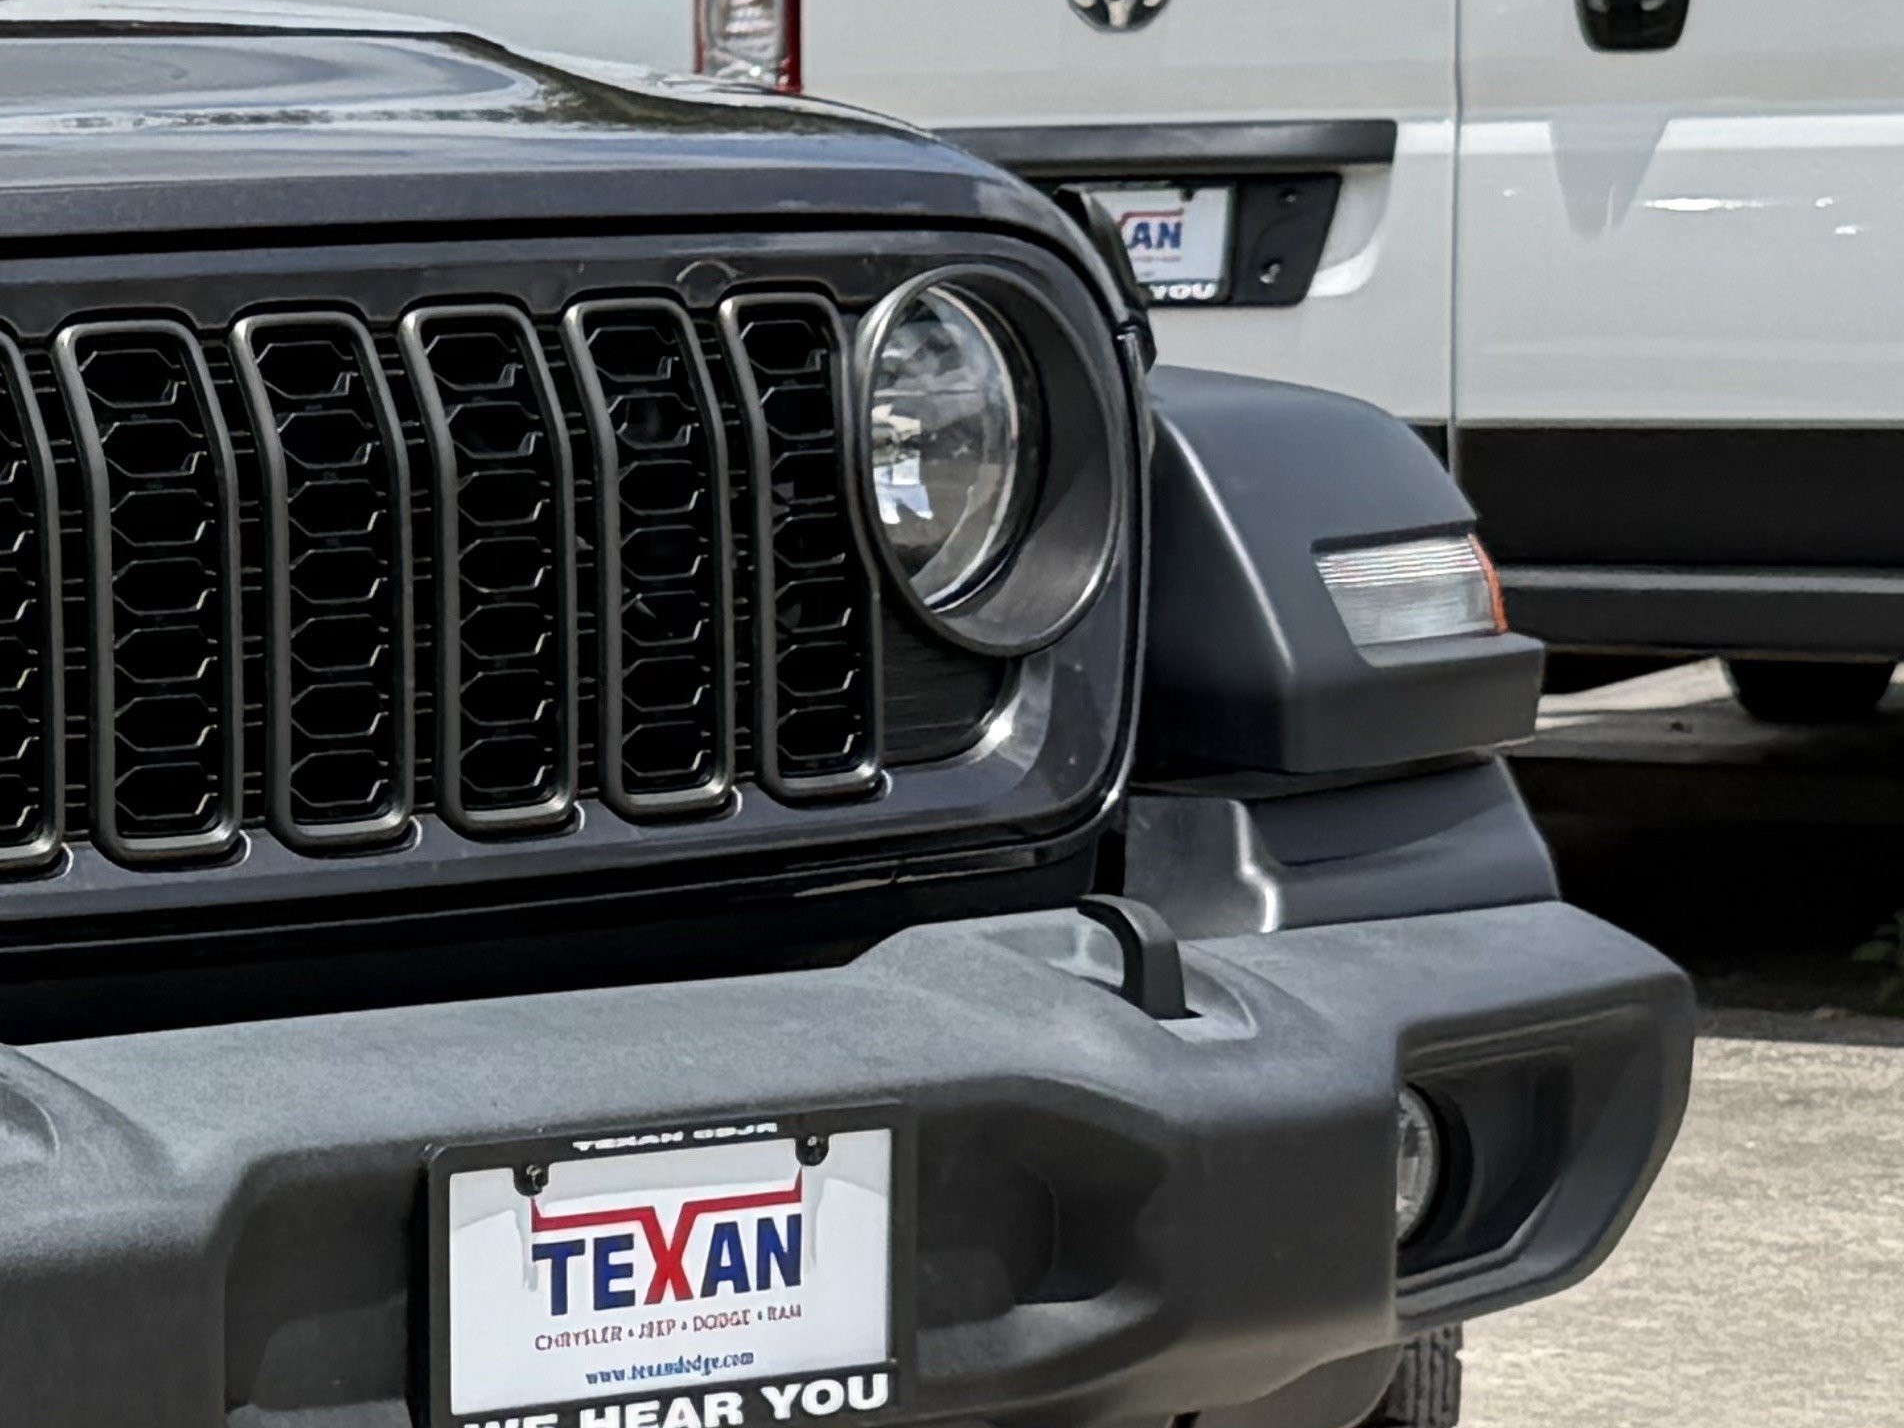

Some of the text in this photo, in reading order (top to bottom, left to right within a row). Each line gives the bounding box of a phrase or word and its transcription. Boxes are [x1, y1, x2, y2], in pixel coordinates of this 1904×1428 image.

[531, 1174, 803, 1318] TEXAN
[692, 1308, 751, 1333] DODGE
[766, 1303, 803, 1322] RAM
[760, 1372, 890, 1421] YOU
